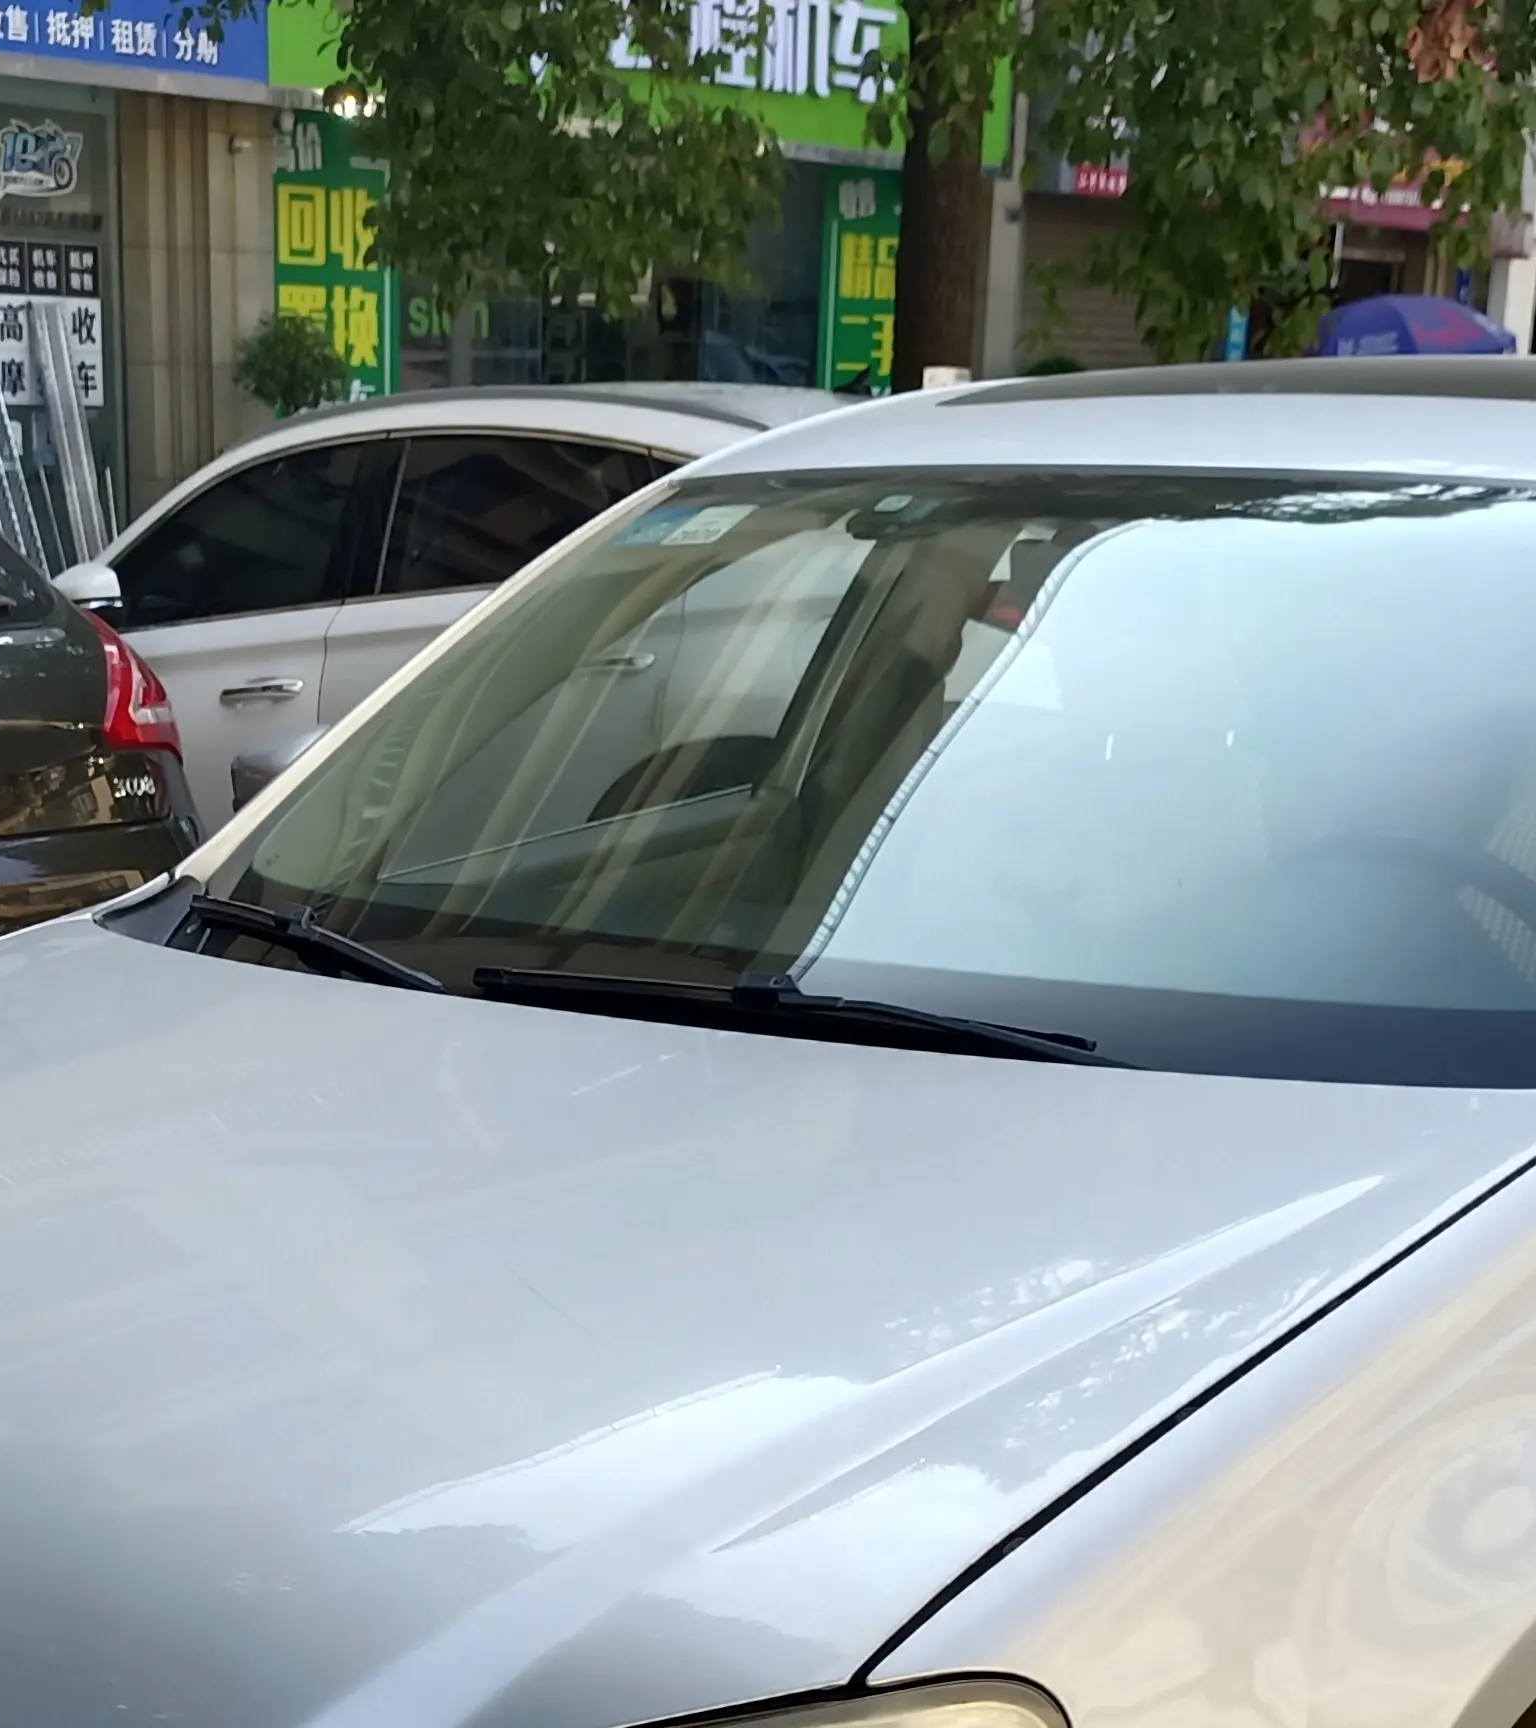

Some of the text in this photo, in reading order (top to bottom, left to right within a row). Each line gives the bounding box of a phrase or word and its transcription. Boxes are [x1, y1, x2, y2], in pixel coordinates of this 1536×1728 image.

[46, 8, 95, 50] 抵押
[110, 18, 157, 57] 租赁
[276, 182, 379, 271] 回收
